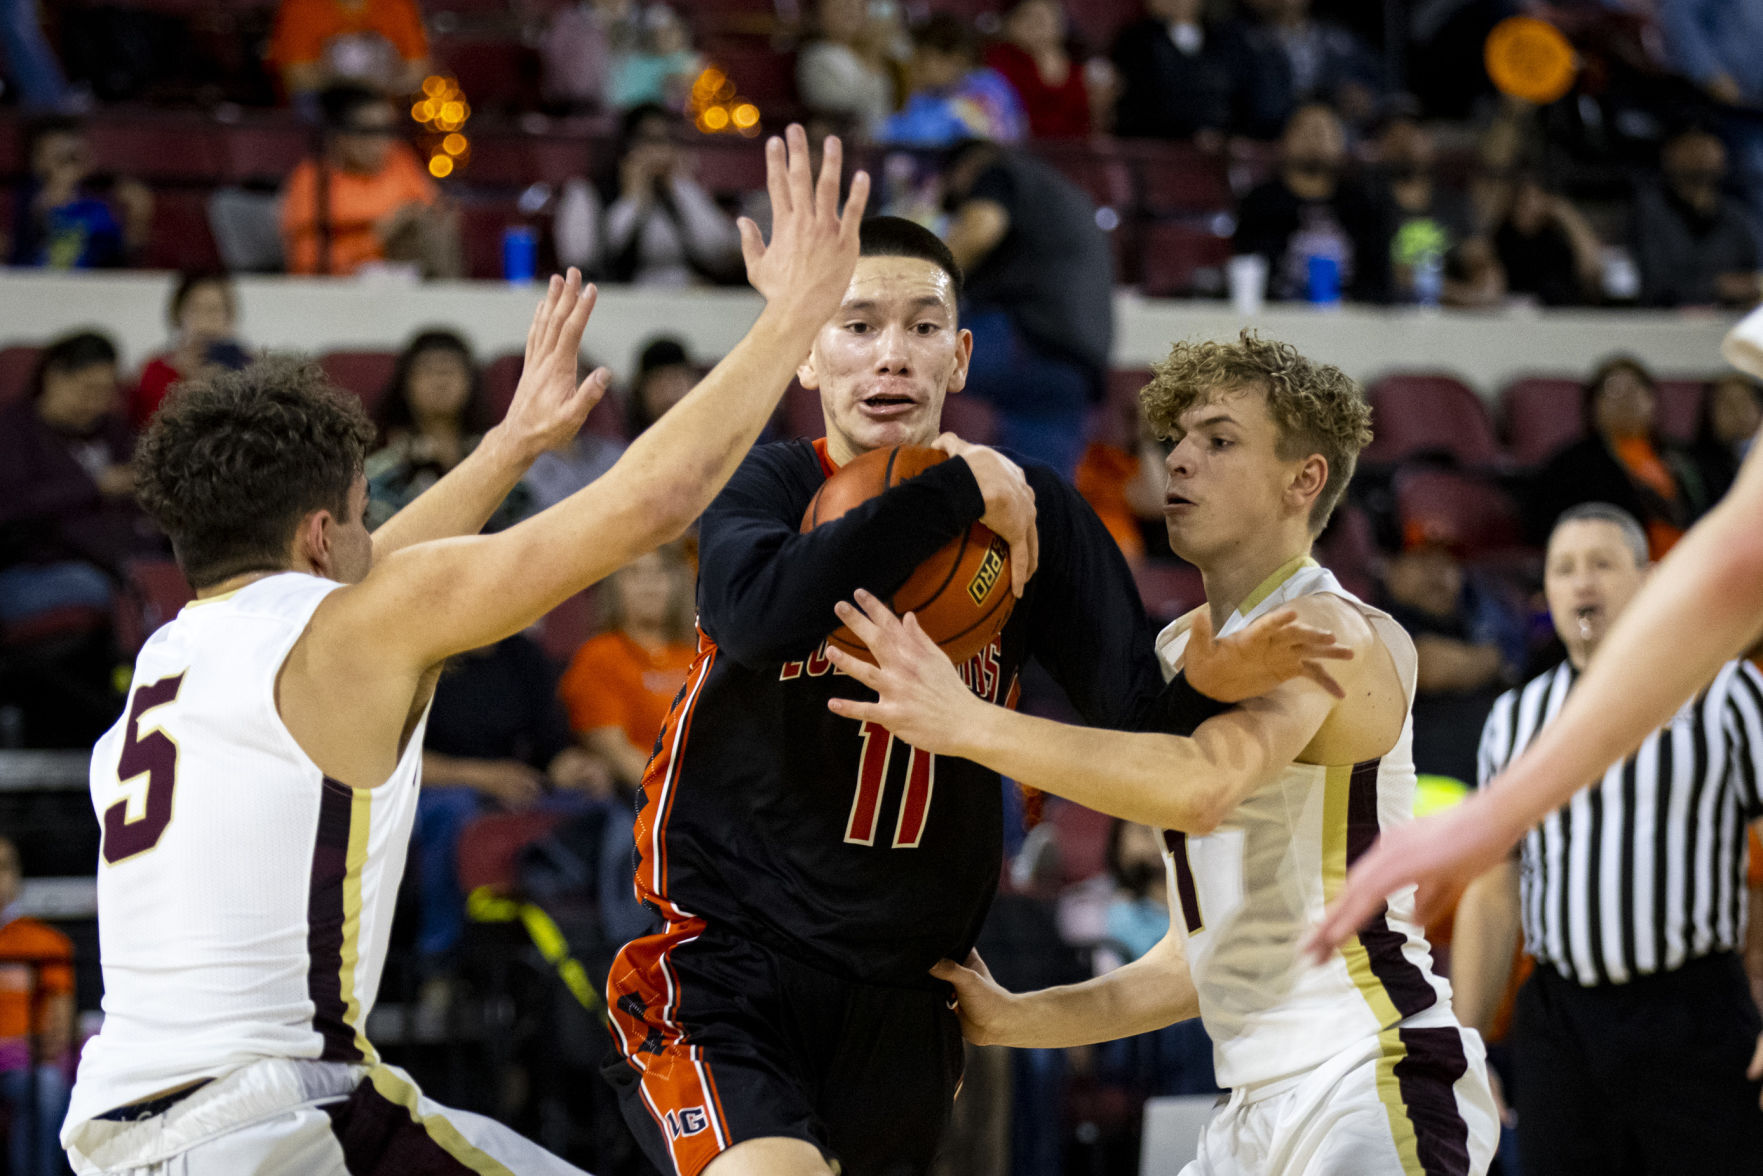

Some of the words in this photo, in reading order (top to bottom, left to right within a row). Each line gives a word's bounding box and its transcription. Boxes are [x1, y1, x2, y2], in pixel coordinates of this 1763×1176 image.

[972, 549, 1002, 600] PRO
[103, 666, 189, 868] 5
[843, 719, 935, 849] 11
[1162, 828, 1206, 938] 1
